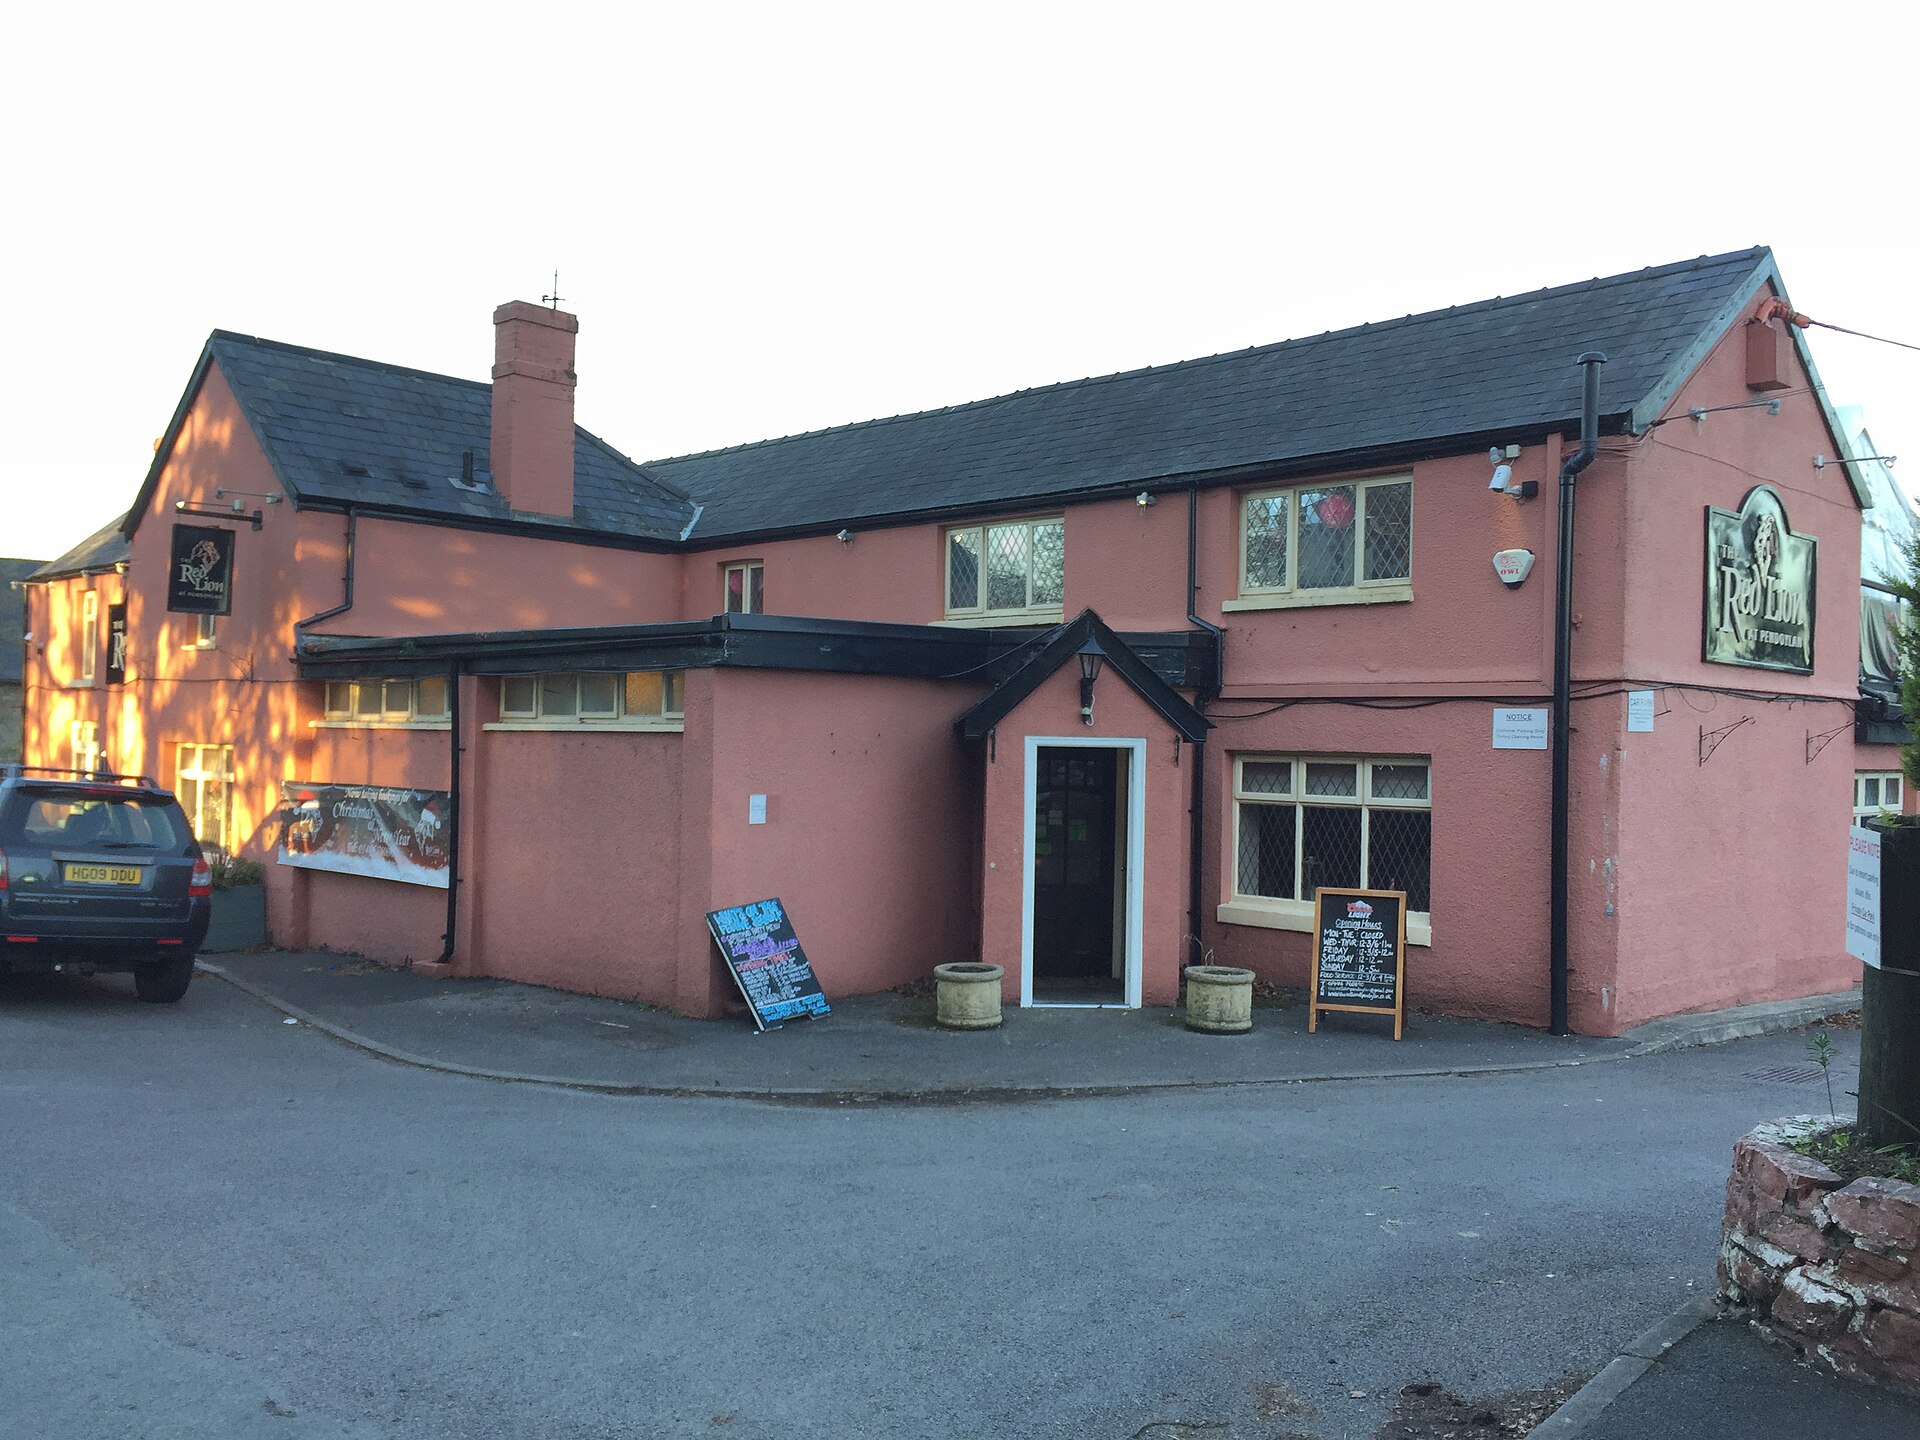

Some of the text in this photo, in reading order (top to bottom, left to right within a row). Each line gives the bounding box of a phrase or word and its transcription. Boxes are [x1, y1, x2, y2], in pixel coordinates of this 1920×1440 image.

[178, 564, 206, 585] Red
[194, 577, 224, 592] Lion
[1719, 564, 1803, 643] Red Lion
[1506, 713, 1532, 721] NOTICE
[344, 786, 361, 799] Now
[332, 801, 375, 820] Christmas
[71, 867, 136, 882] HG09 DDU
[1335, 918, 1383, 931] Opening Hours
[1360, 931, 1385, 940] CLOSED
[1322, 946, 1349, 956] FRIDAY
[1321, 953, 1355, 964] SATURDAY
[1320, 961, 1346, 971] SUNDAY
[1319, 971, 1335, 979] FOOD
